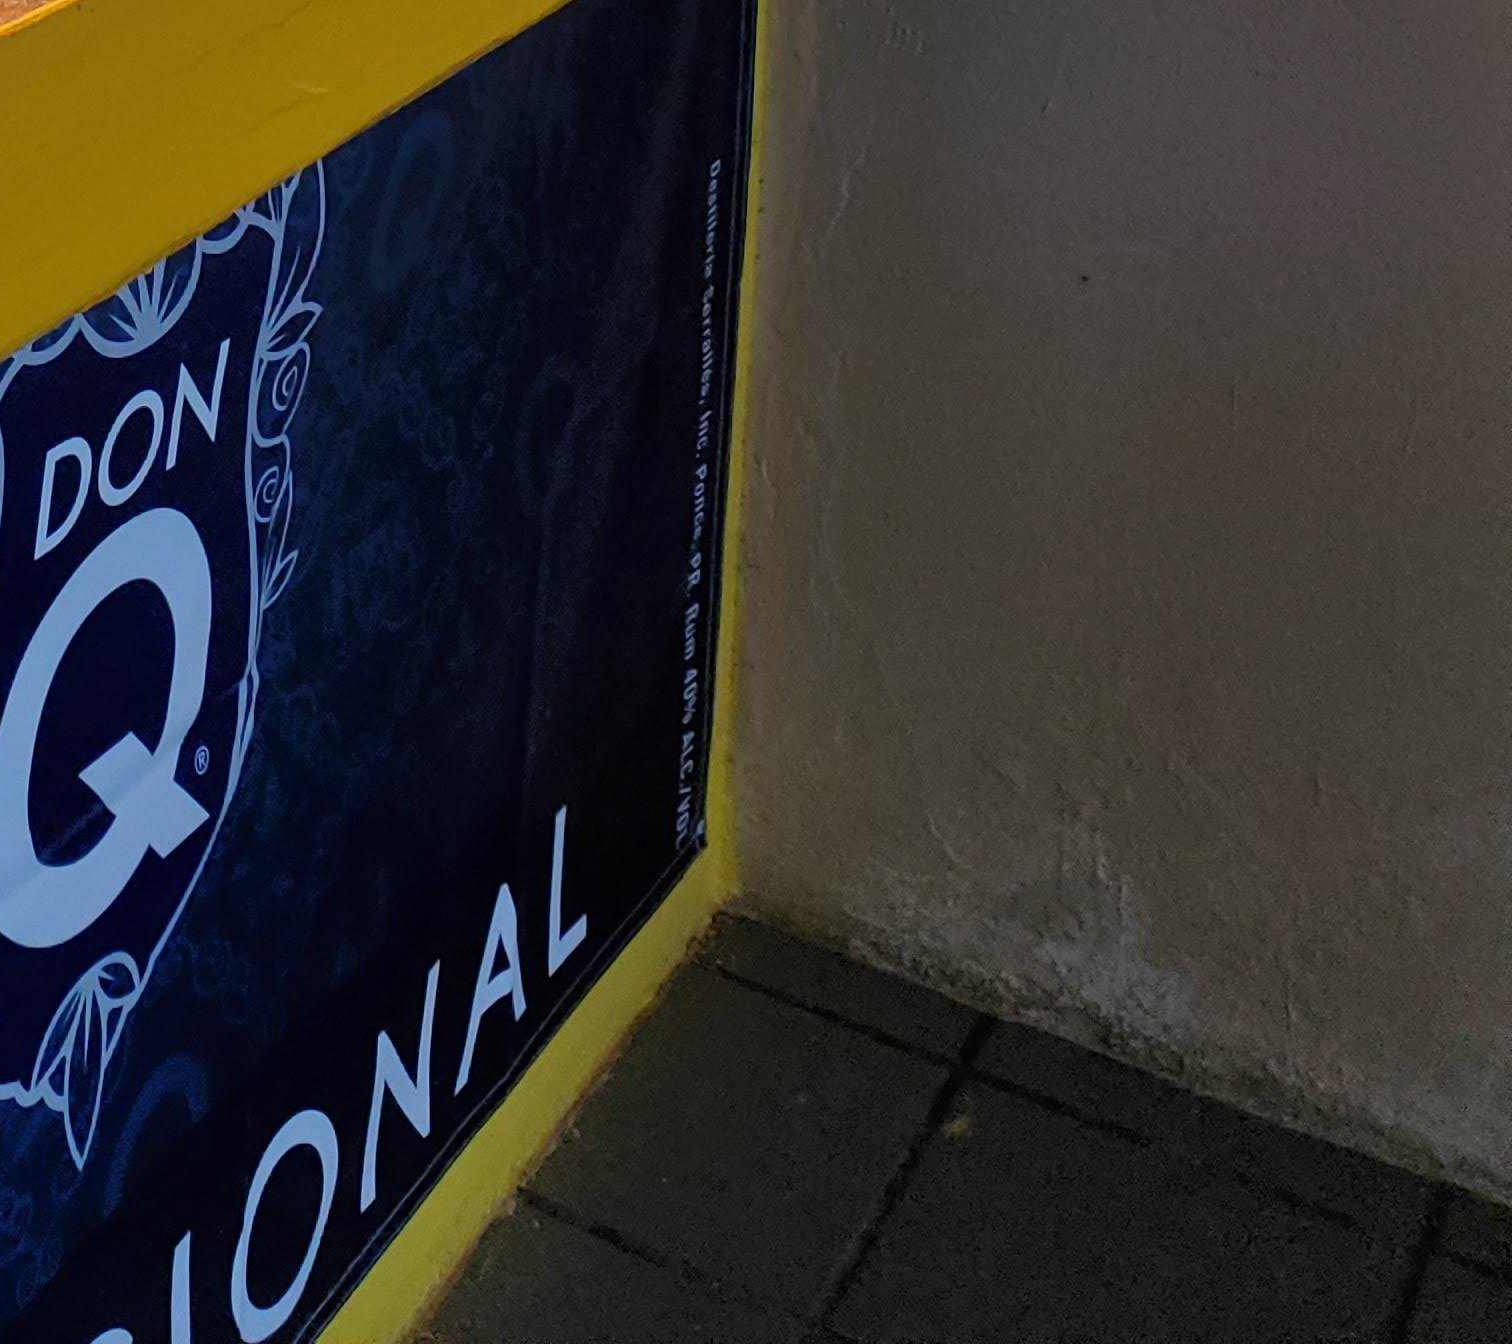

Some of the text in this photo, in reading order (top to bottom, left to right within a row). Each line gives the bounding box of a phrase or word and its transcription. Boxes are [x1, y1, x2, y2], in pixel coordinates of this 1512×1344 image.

[32, 338, 231, 560] DON
[681, 667, 699, 725] 40%
[683, 602, 700, 661] Rum
[88, 804, 588, 1344] IONAL
